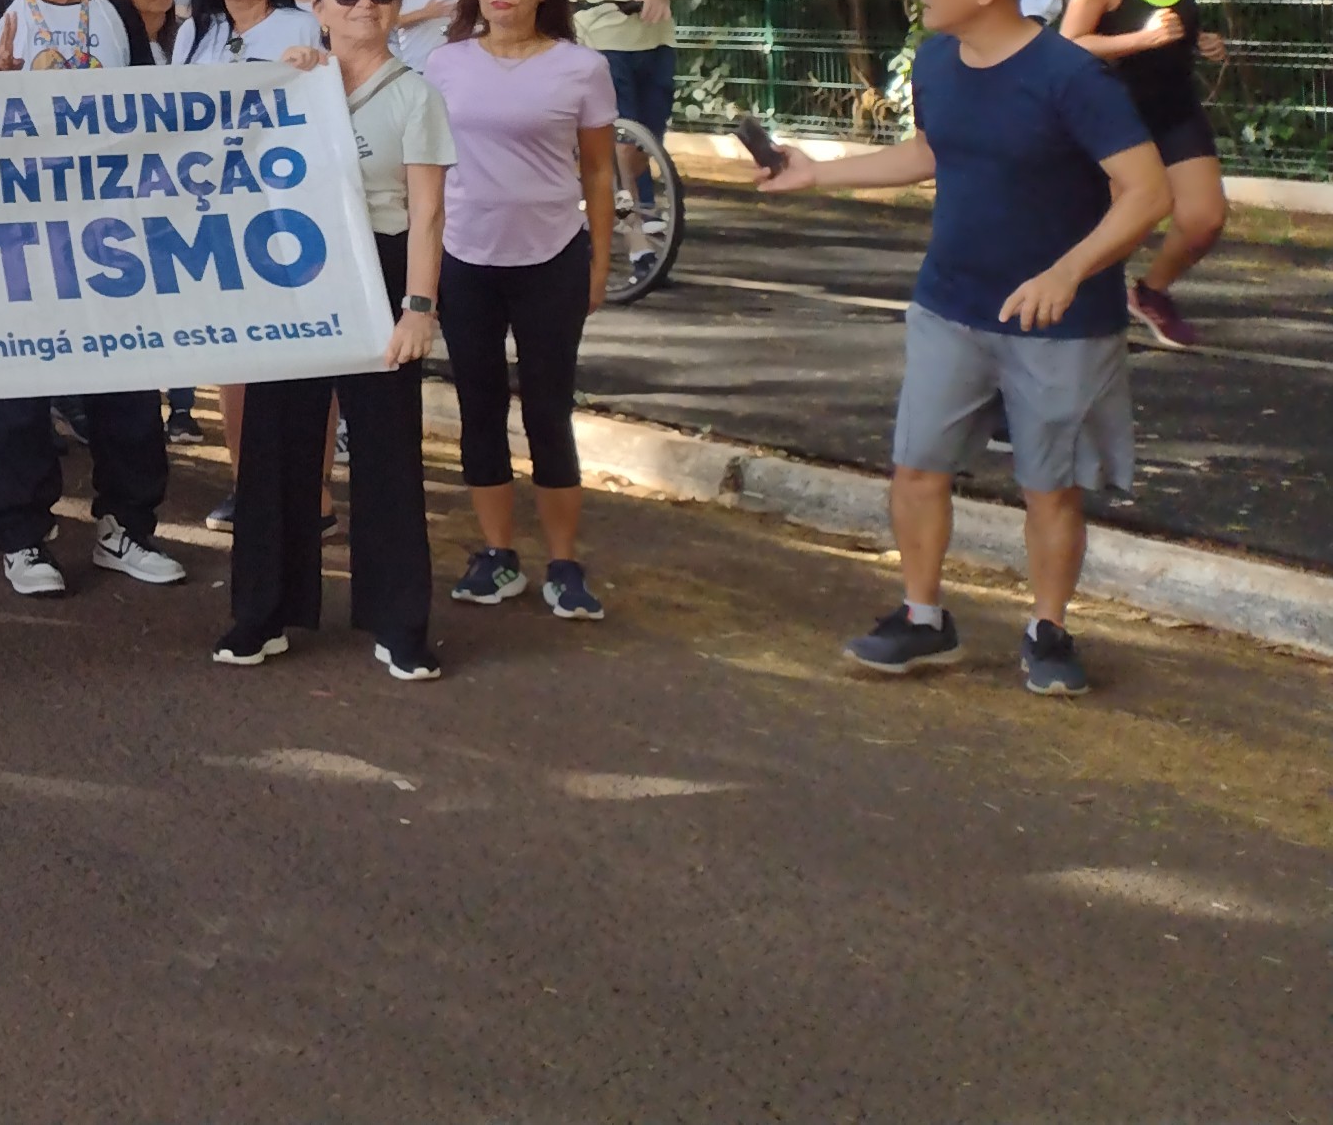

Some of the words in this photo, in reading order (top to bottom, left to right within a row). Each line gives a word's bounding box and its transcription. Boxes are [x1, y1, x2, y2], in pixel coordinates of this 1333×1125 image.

[33, 30, 100, 47] ATISO
[52, 88, 307, 135] MUNDIAL
[83, 325, 165, 359] apoia
[173, 323, 238, 347] esta
[246, 313, 343, 342] causa!
